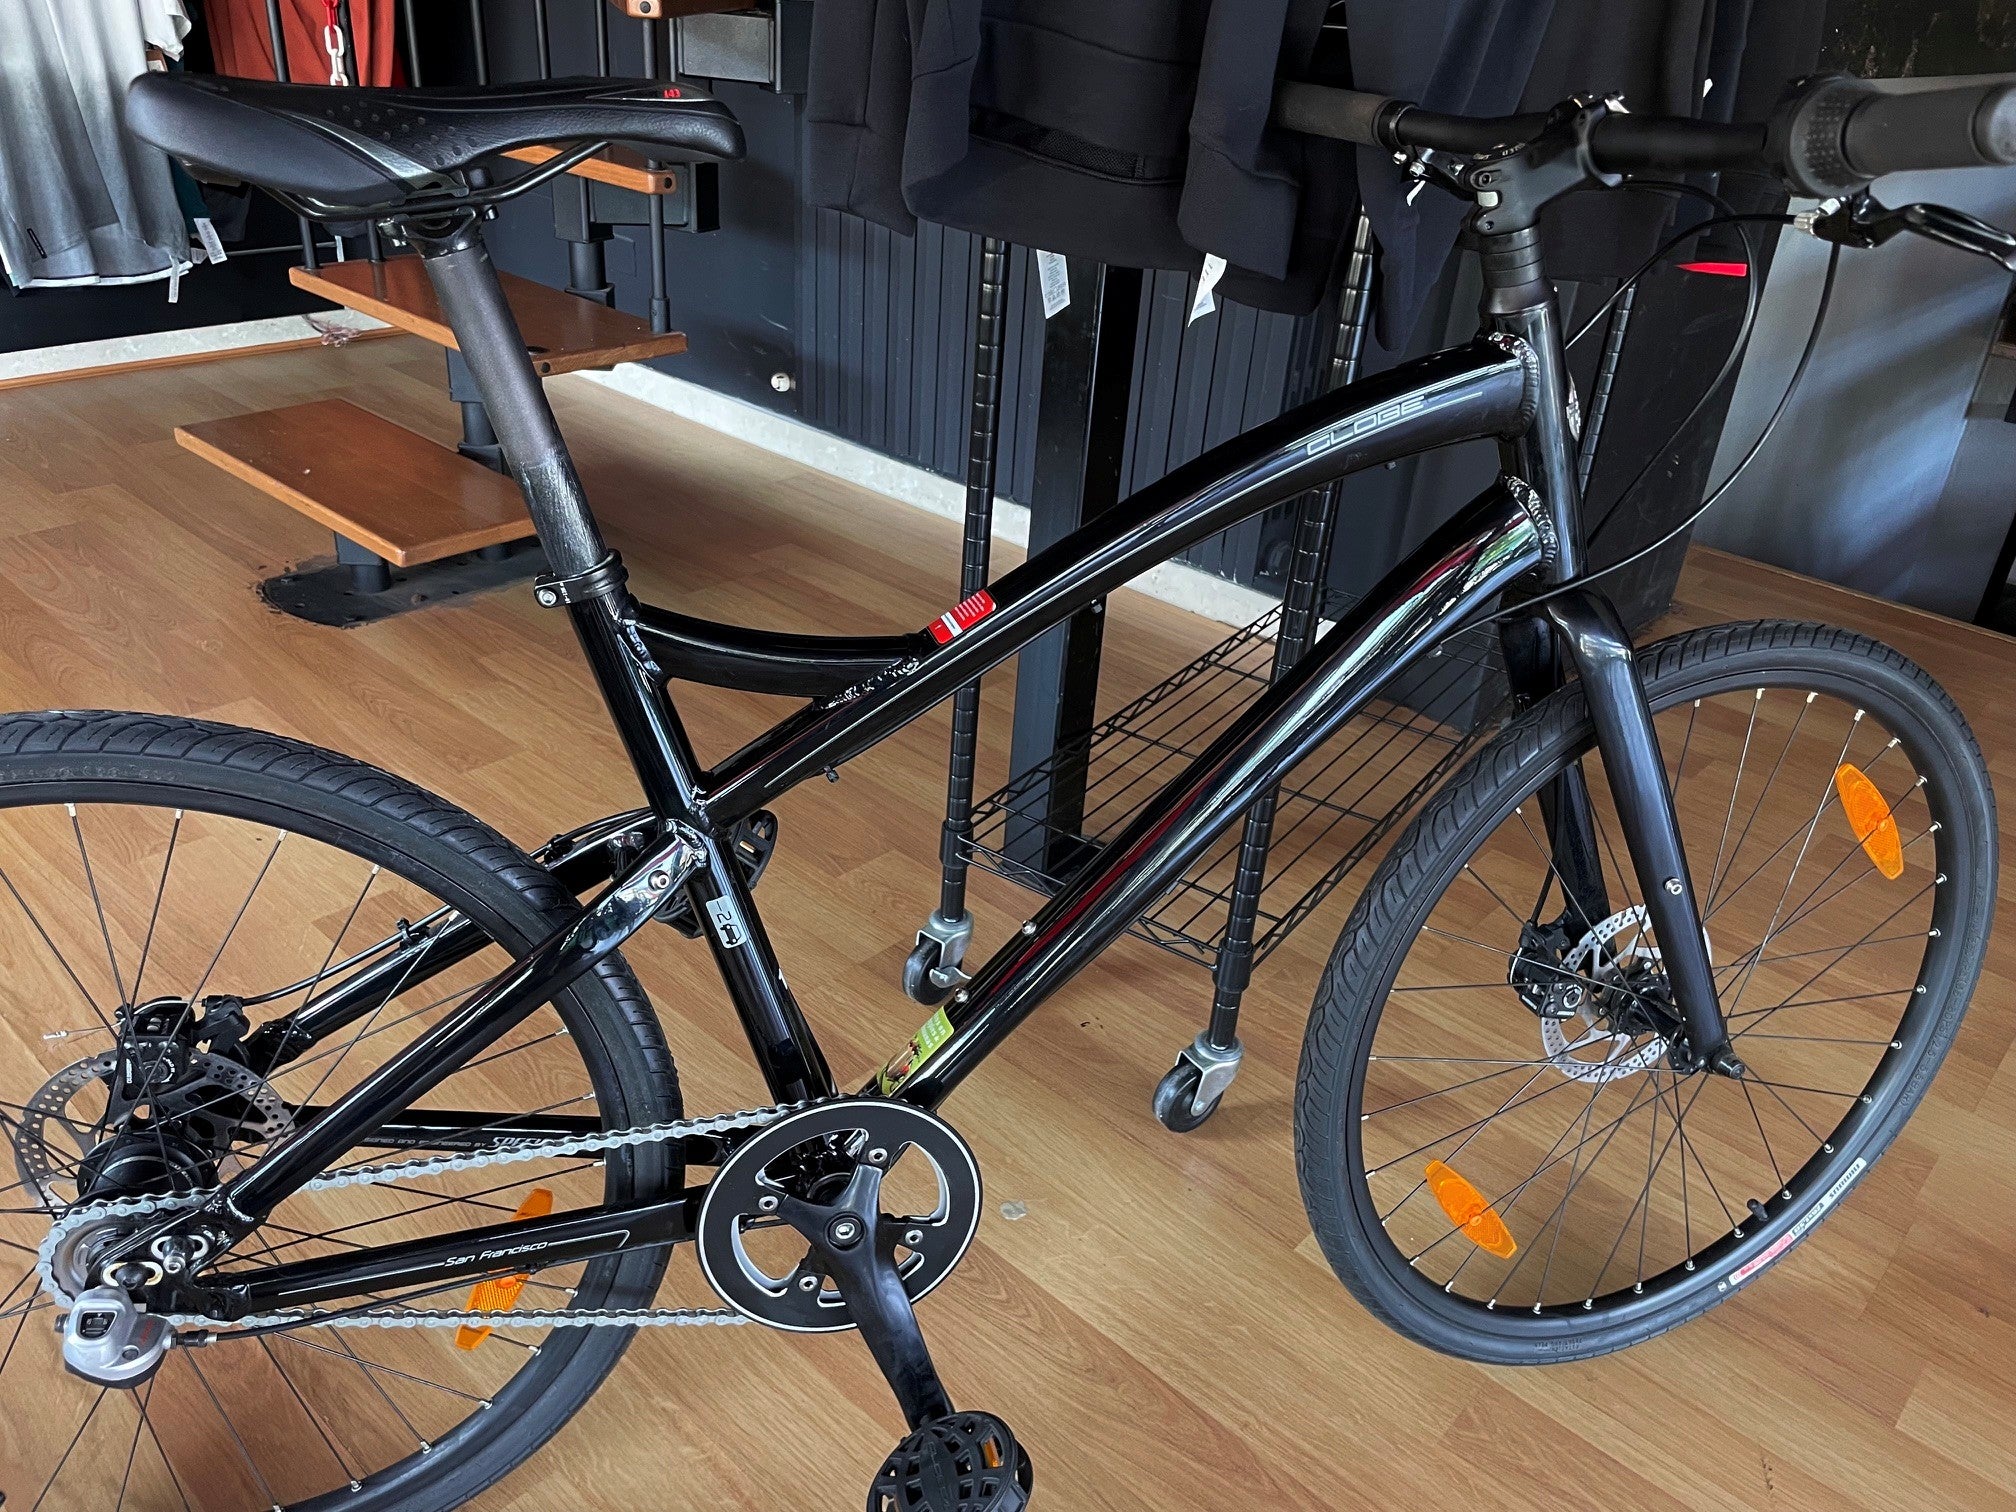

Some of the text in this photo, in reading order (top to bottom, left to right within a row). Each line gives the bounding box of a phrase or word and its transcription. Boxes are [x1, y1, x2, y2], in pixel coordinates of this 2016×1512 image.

[1306, 395, 1425, 456] GLOBE
[445, 1241, 549, 1267] San Francisco
